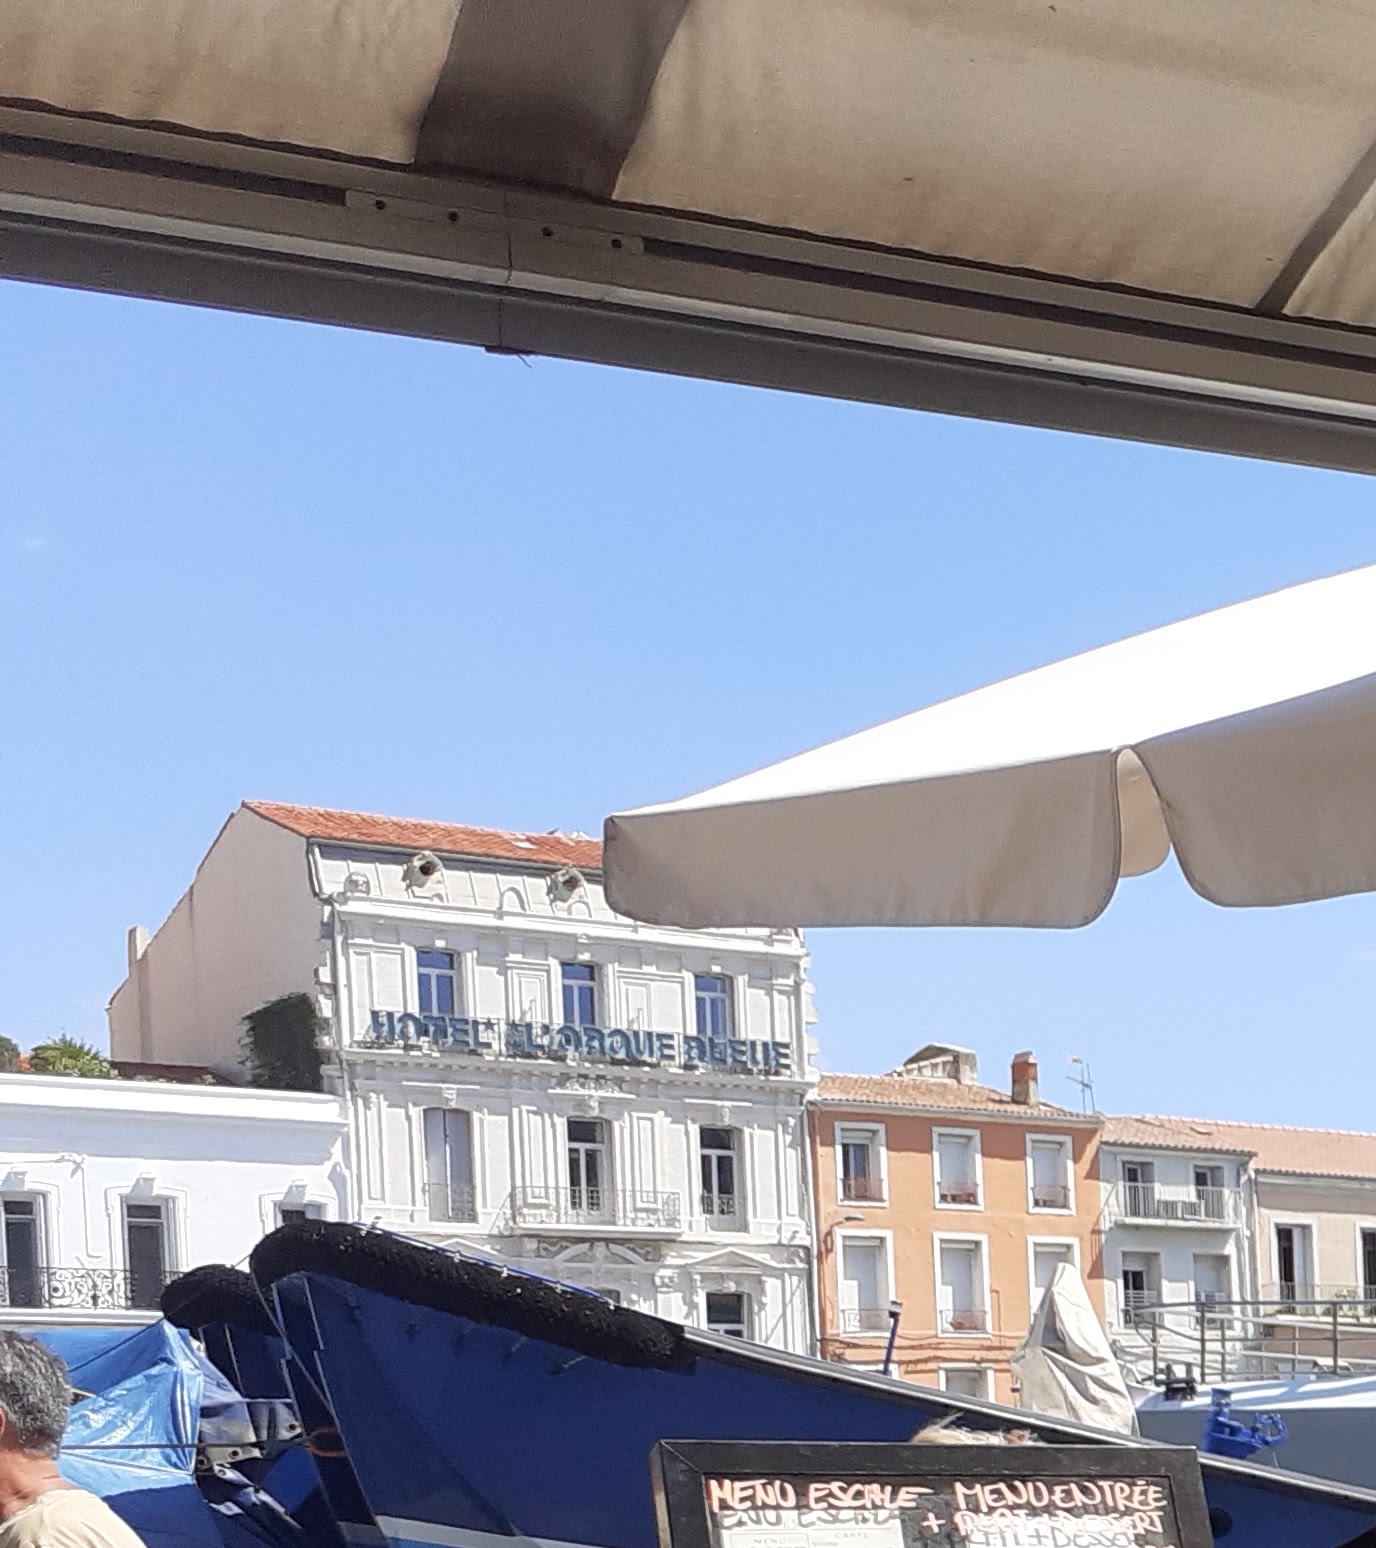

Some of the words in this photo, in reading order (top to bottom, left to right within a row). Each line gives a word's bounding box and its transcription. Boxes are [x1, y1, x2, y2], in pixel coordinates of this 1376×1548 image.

[370, 1009, 492, 1051] HOTEL
[707, 1478, 796, 1513] MENU
[808, 1480, 934, 1511] ESCALE
[954, 1480, 1048, 1513] MENU
